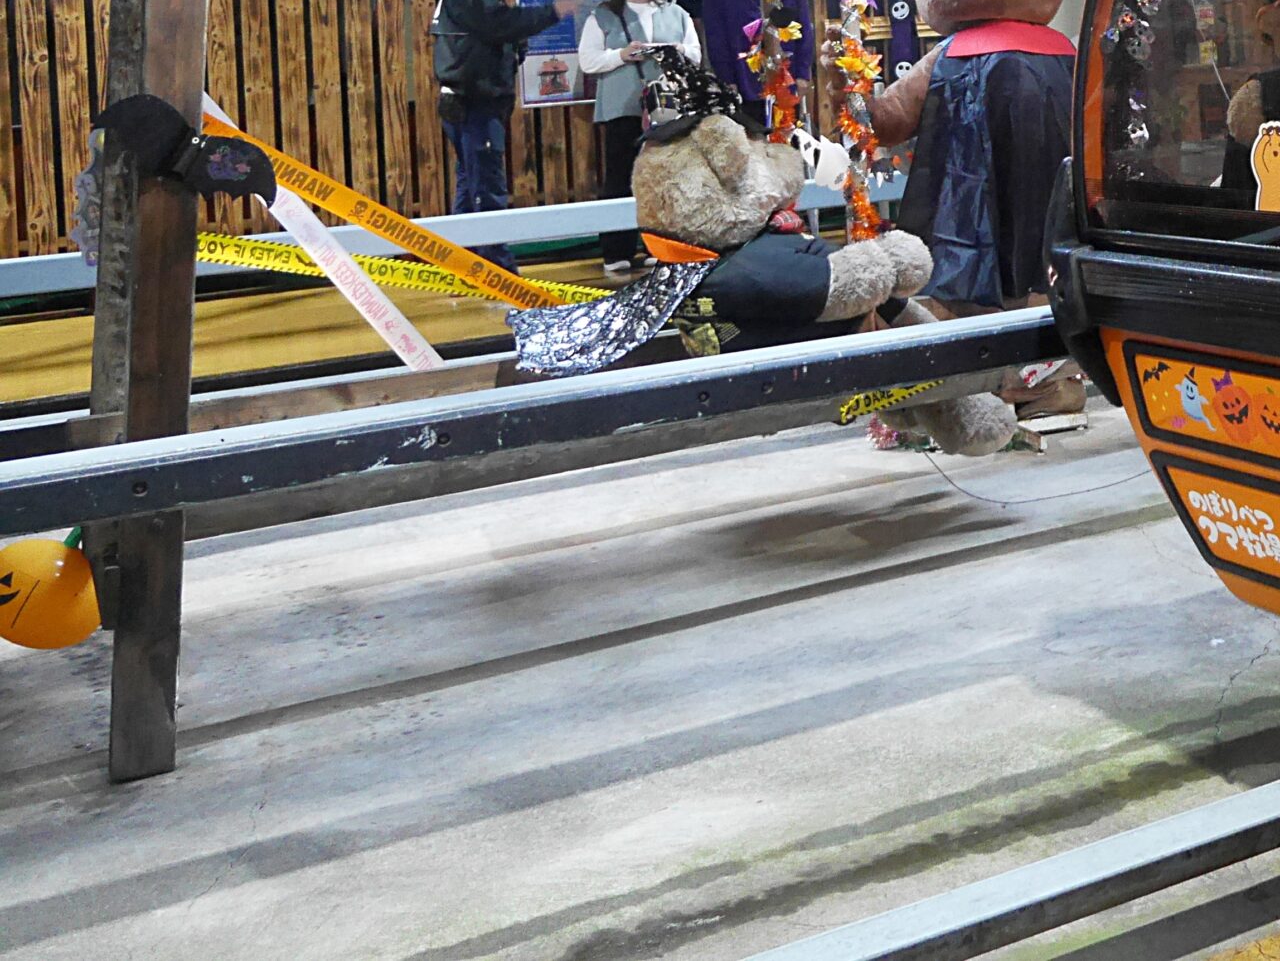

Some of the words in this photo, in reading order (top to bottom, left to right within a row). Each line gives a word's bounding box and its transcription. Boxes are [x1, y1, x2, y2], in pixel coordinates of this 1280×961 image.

[1188, 490, 1275, 530] のぼりべつ
